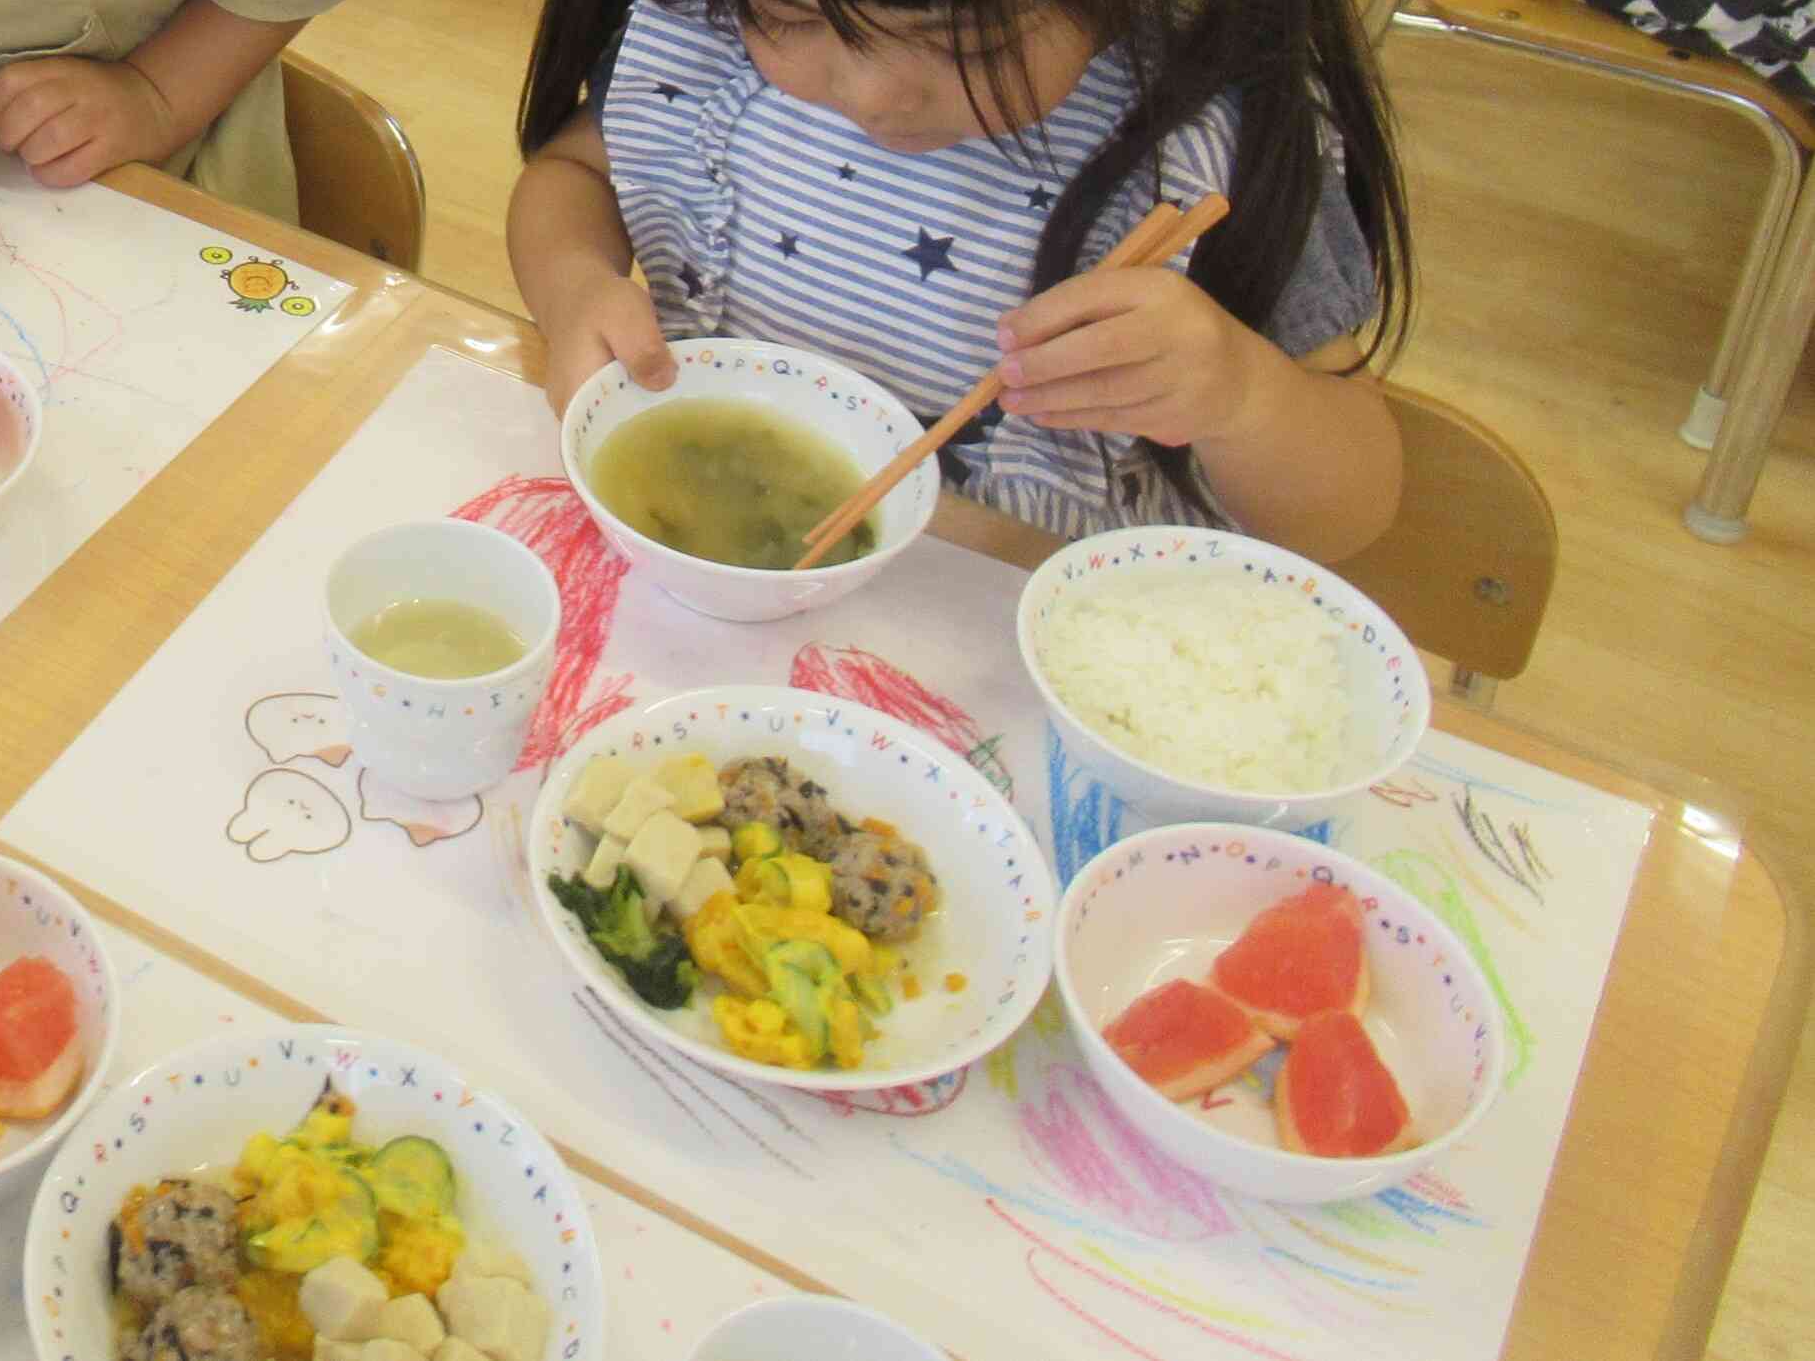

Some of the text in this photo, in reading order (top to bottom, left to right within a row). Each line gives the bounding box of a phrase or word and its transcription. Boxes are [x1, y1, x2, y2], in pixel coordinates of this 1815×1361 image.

[701, 350, 713, 363] O
[773, 360, 790, 375] Q
[816, 376, 828, 389] R
[846, 396, 857, 410] S
[1089, 554, 1105, 569] W
[1129, 544, 1145, 560] X
[1172, 540, 1186, 552] Y
[1207, 541, 1222, 557] Z
[1264, 568, 1277, 582] A
[1301, 579, 1316, 593] B
[1363, 625, 1375, 643] D
[633, 732, 642, 750] R
[674, 722, 687, 739] S
[716, 704, 728, 719] T
[770, 716, 784, 732] U
[826, 709, 839, 725] V
[872, 731, 890, 749] W
[926, 766, 941, 781] X
[1226, 841, 1245, 857] O
[1313, 866, 1333, 883] Q
[1362, 896, 1377, 911] R
[61, 1192, 78, 1213] Q
[130, 1113, 145, 1132] S
[225, 1068, 240, 1086] U
[279, 1040, 293, 1058] V
[401, 1067, 416, 1086] X
[500, 1124, 514, 1145] Z
[534, 1185, 547, 1202] A
